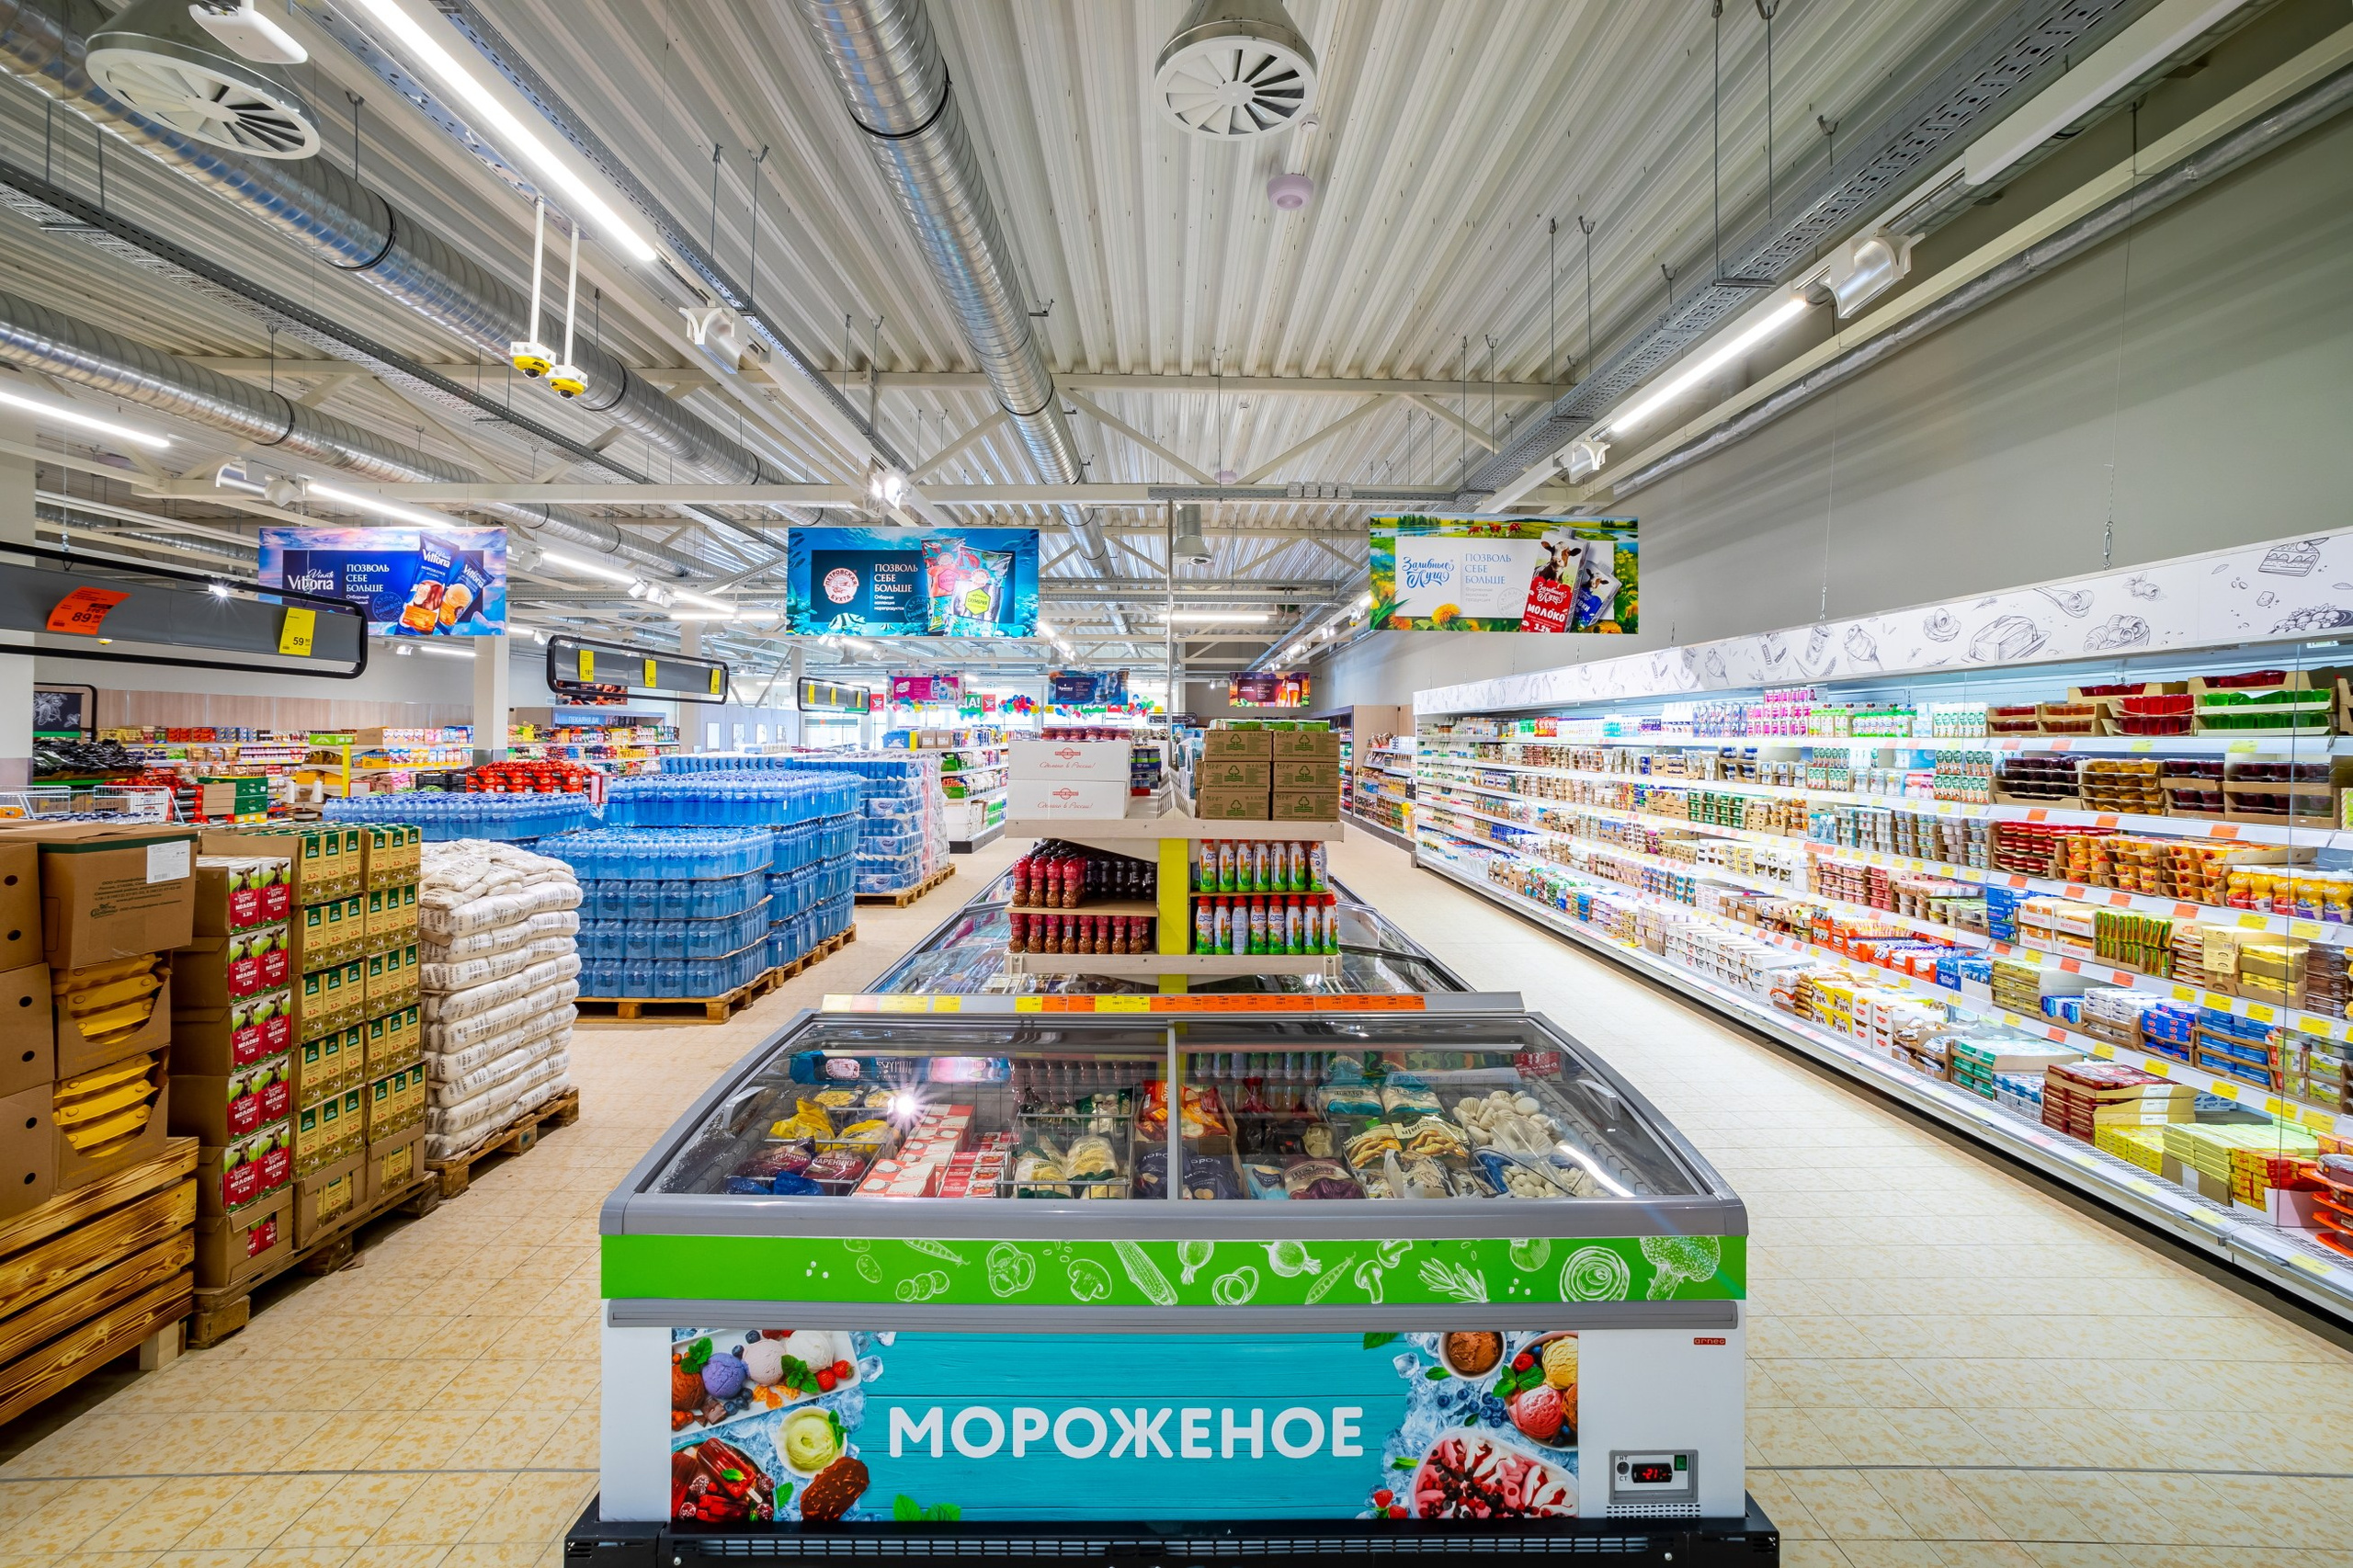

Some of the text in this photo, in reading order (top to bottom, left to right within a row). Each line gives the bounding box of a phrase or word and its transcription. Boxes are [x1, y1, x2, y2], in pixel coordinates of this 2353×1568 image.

[1465, 553, 1512, 562] ПОЗВОЛЬ
[347, 563, 390, 573] ПОЗВОЛЬ
[874, 563, 918, 573] ПОЗВОЛЬ
[1402, 556, 1454, 572] Заливные
[1464, 564, 1487, 574] СЕБЕ
[346, 574, 368, 583] СЕБЕ
[824, 569, 858, 585] ПЕТРОВСКАЯ
[873, 574, 896, 583] СЕБЕ
[1406, 570, 1449, 588] Луга
[1465, 575, 1506, 585] БОЛЬШЕ
[347, 585, 383, 593] БОЛЬШЕ
[874, 585, 913, 593] БОЛЬШЕ
[830, 594, 851, 602] БУХТА
[72, 612, 92, 622] 89
[1527, 603, 1565, 622] МОЛОКО
[293, 636, 304, 645] 59
[568, 716, 591, 724] ПЕКАРНЯ
[267, 896, 286, 904] МОЛОКО
[235, 901, 257, 911] МОЛОКО
[266, 961, 285, 971] МОЛОКО
[235, 970, 257, 980] МОЛОКО
[268, 1028, 287, 1038] МОЛОКО
[238, 1038, 259, 1049] МОЛОКО
[266, 1094, 286, 1106] МОЛОКО
[234, 1106, 256, 1119] МОЛОКО
[265, 1160, 286, 1173] МОЛОКО
[231, 1175, 255, 1188] МОЛОКО
[890, 1406, 1363, 1459] МОРОЖЕНОЕ
[1643, 1468, 1658, 1480] -21
